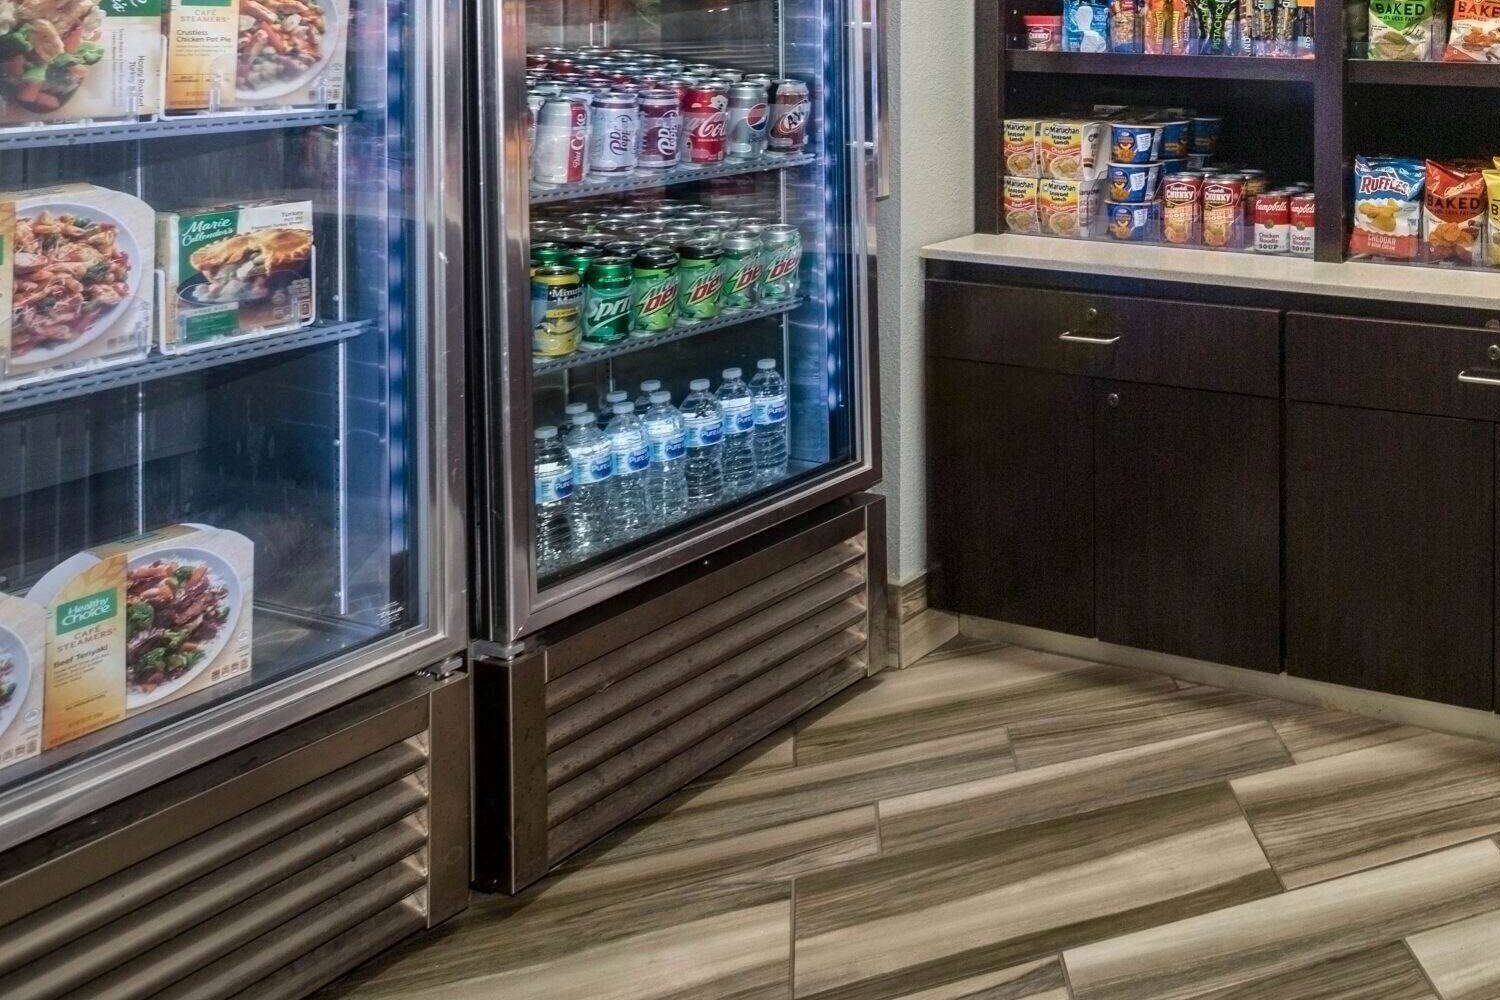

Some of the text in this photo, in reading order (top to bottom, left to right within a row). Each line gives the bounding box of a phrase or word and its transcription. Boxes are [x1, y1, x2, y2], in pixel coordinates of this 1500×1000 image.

[1375, 2, 1426, 16] BAKED
[180, 15, 228, 24] STEAMERS
[570, 113, 587, 151] Coke
[1006, 123, 1032, 132] Maruchan
[1049, 126, 1080, 135] Maruchan
[1006, 180, 1034, 189] Maruchan
[1048, 183, 1076, 192] Maruchan
[1359, 175, 1410, 195] RUFFLES
[1166, 190, 1194, 200] CHUNKY
[1204, 193, 1231, 203] CHUNKY
[1256, 199, 1287, 213] Campbell's
[1427, 195, 1481, 212] BAKED
[183, 216, 232, 236] Marie
[182, 227, 234, 248] Callender's
[1291, 234, 1312, 242] Chicken
[1368, 234, 1397, 246] CHEDDAR
[68, 597, 110, 616] Healthy
[62, 604, 110, 627] Choice
[57, 629, 114, 652] STEAMERS
[53, 645, 109, 669] Beef Teriyaki
